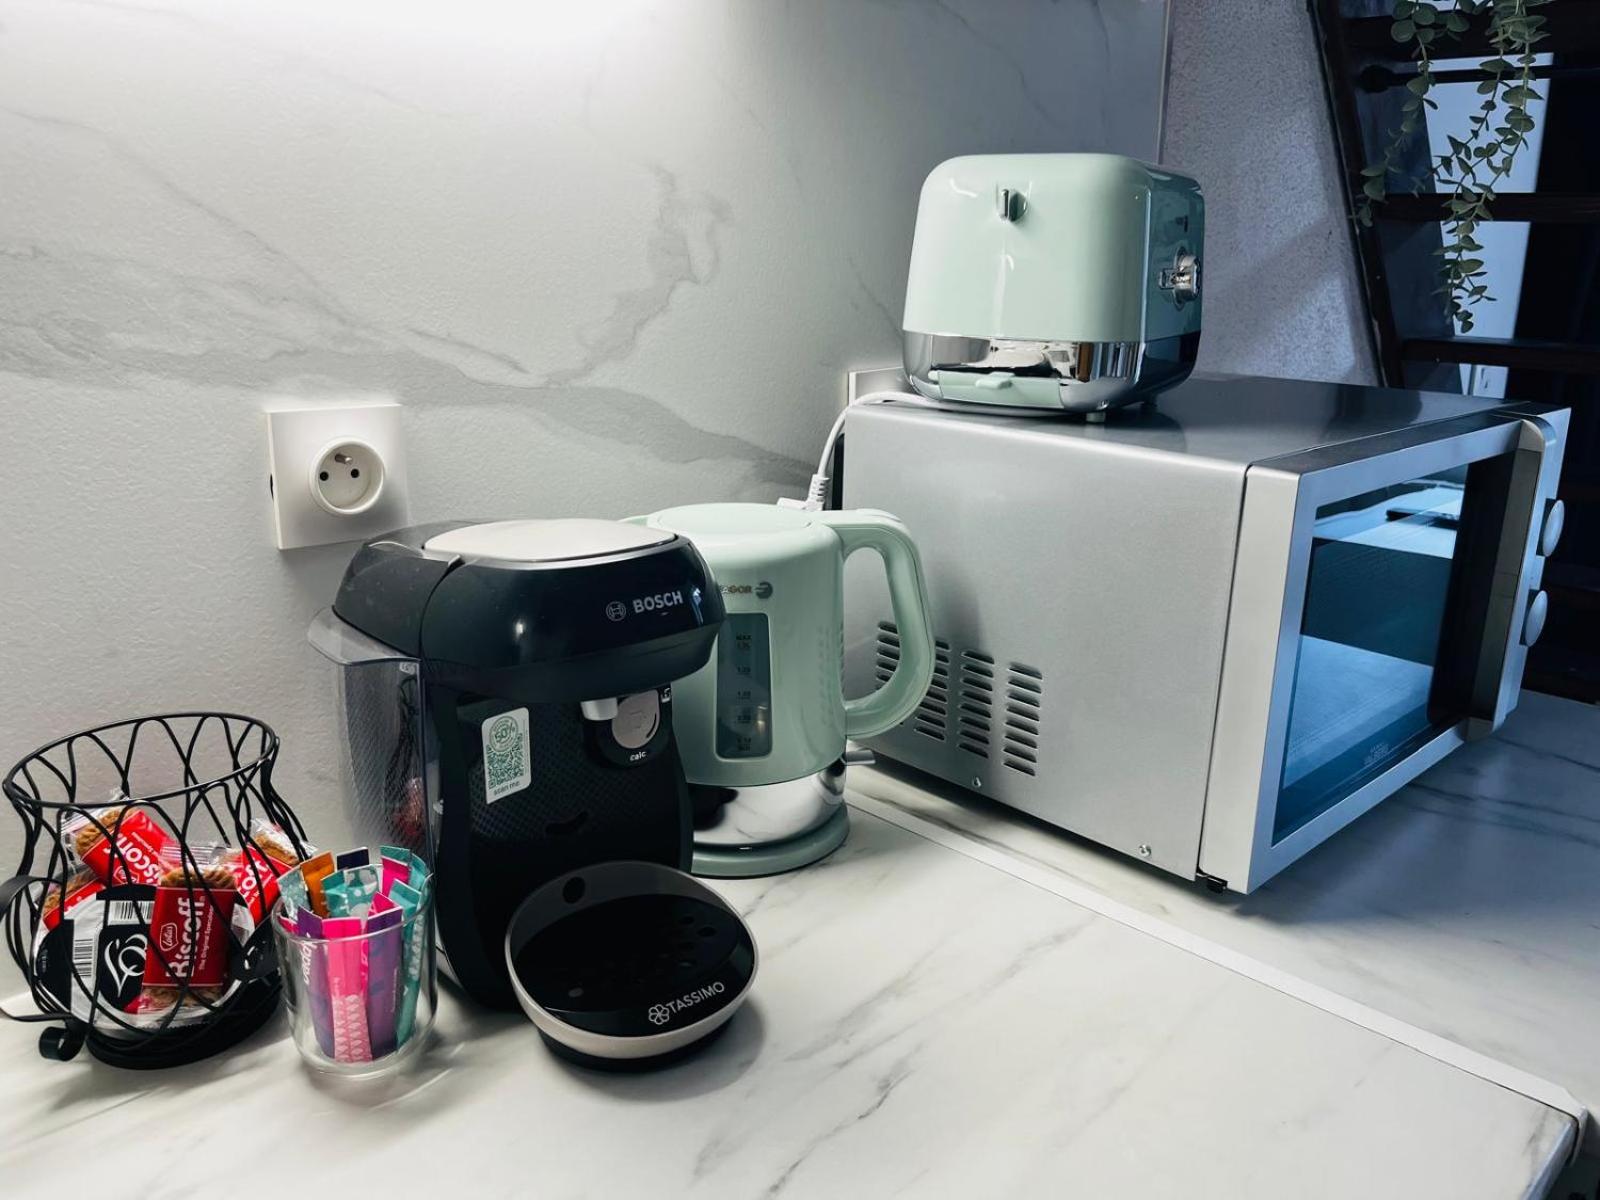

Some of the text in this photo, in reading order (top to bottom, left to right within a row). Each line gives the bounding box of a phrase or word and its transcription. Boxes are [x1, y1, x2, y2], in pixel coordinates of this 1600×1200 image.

[633, 591, 683, 613] BOSCH
[630, 751, 647, 762] calc
[165, 897, 205, 977] Biscoff
[666, 981, 725, 1014] TASSIMO
